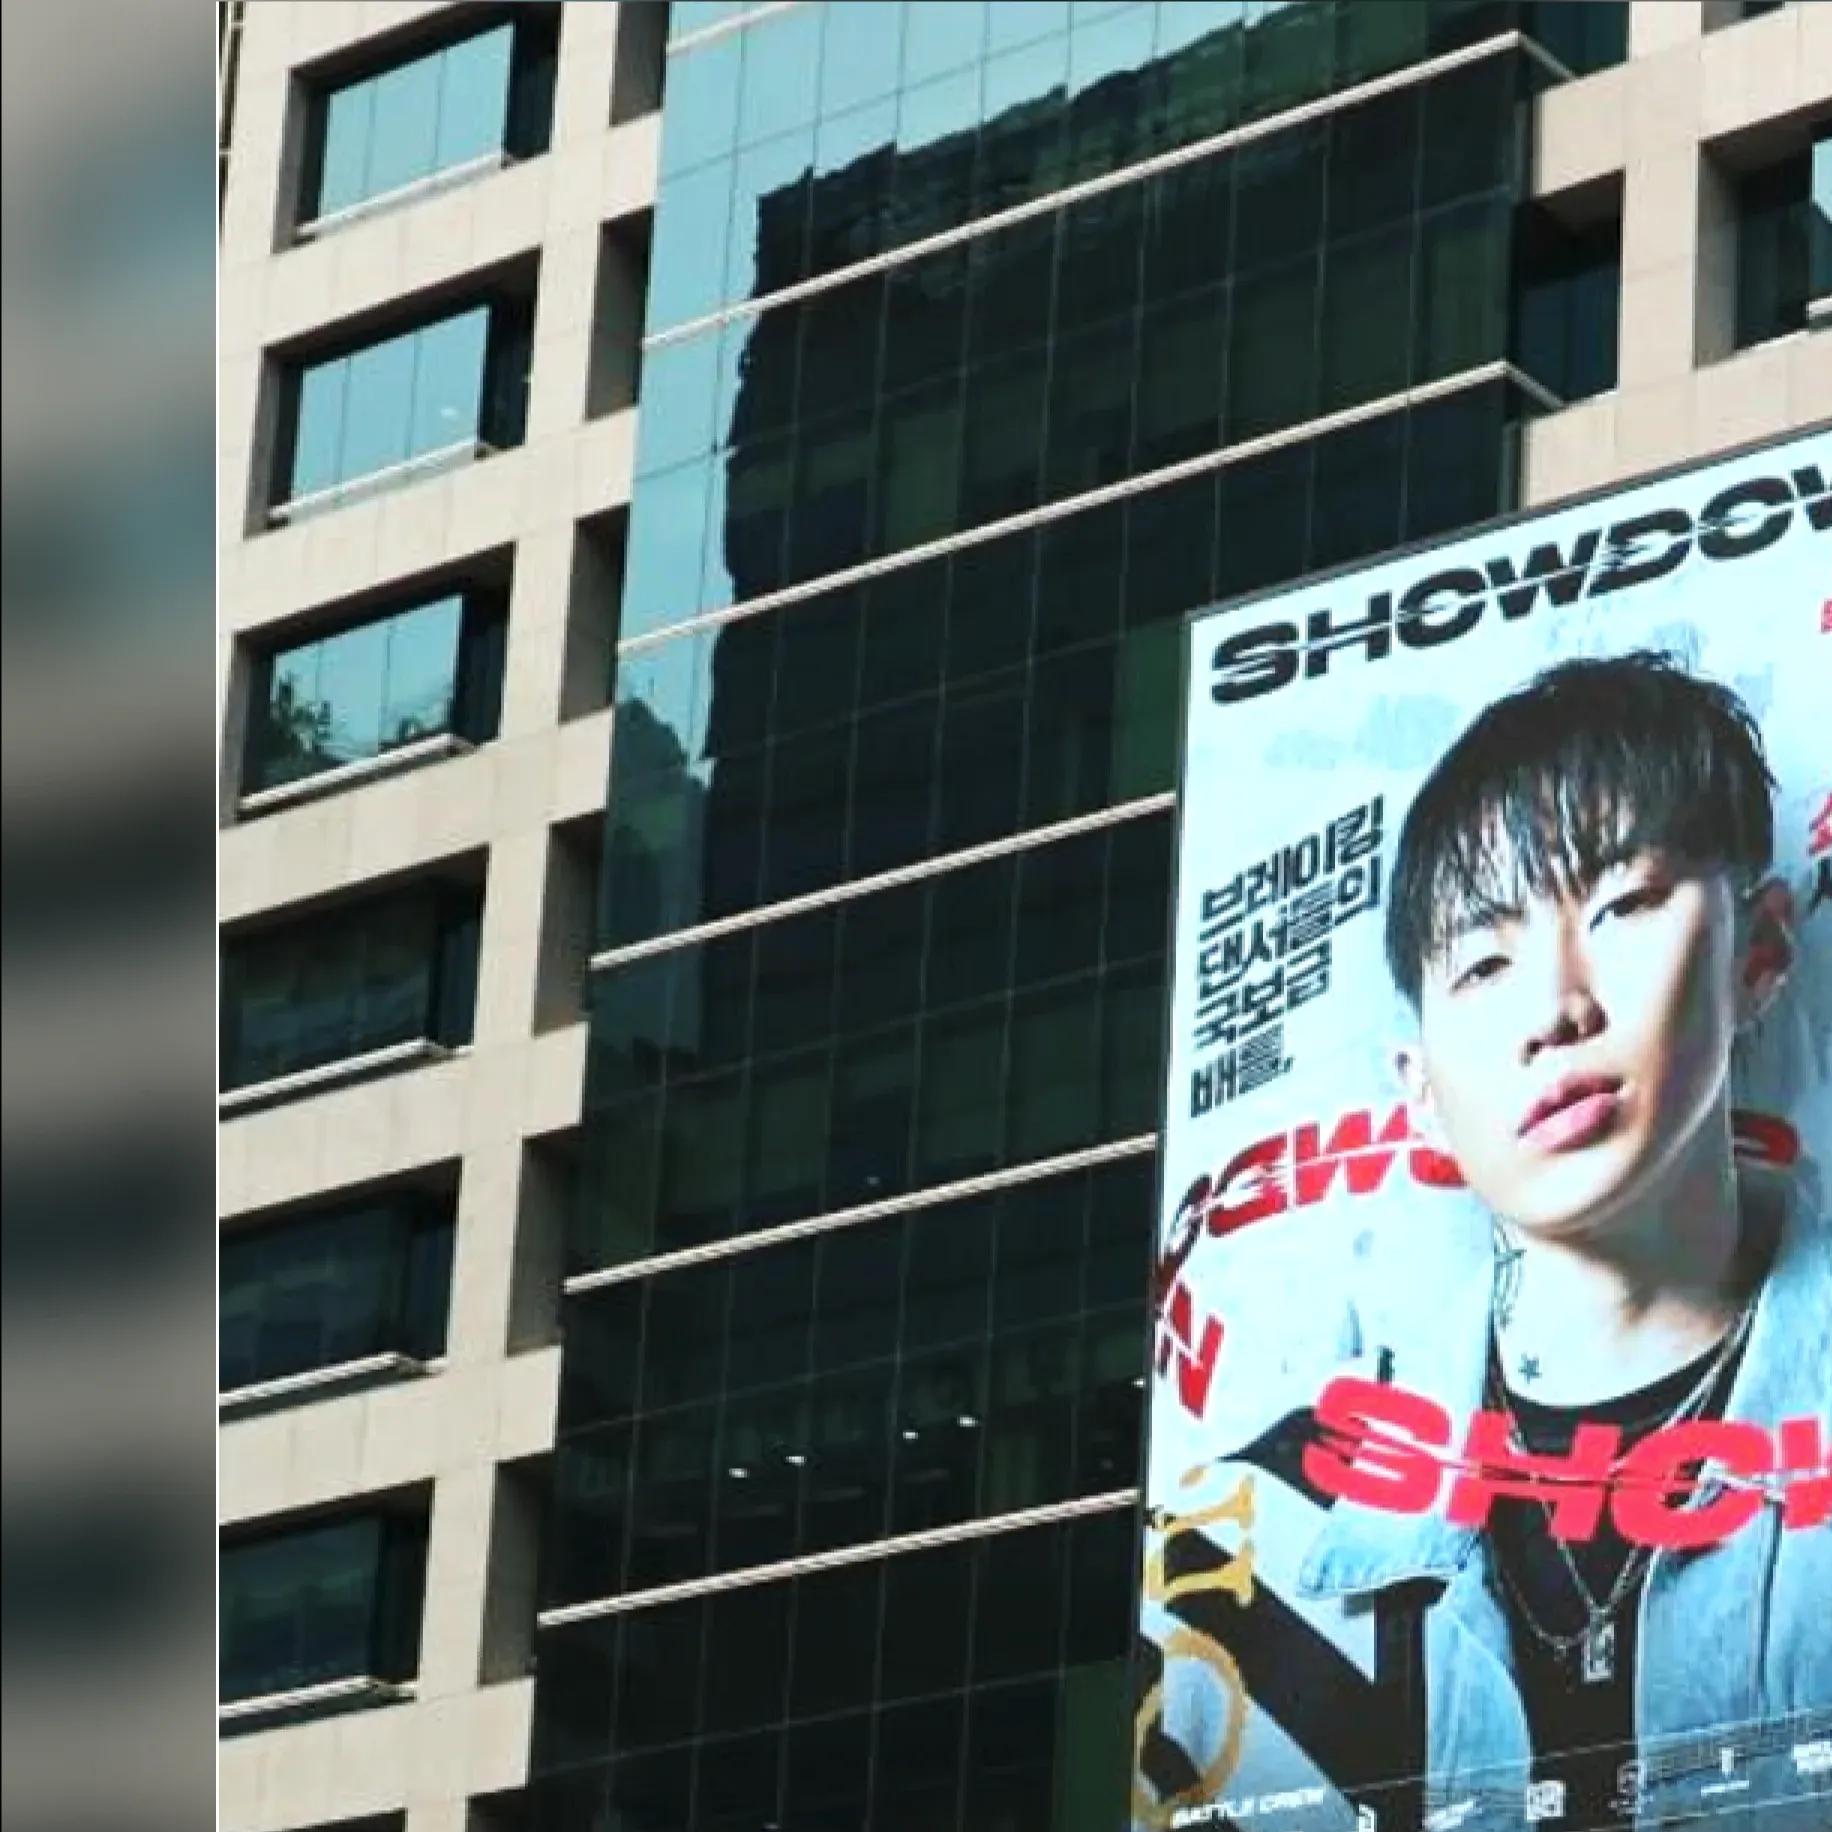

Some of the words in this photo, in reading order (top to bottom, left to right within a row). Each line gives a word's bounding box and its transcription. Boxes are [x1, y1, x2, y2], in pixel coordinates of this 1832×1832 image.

[1196, 854, 1382, 1001] 댄서들의
[1199, 793, 1384, 942] 브레이킹
[1193, 937, 1332, 1050] 국보급
